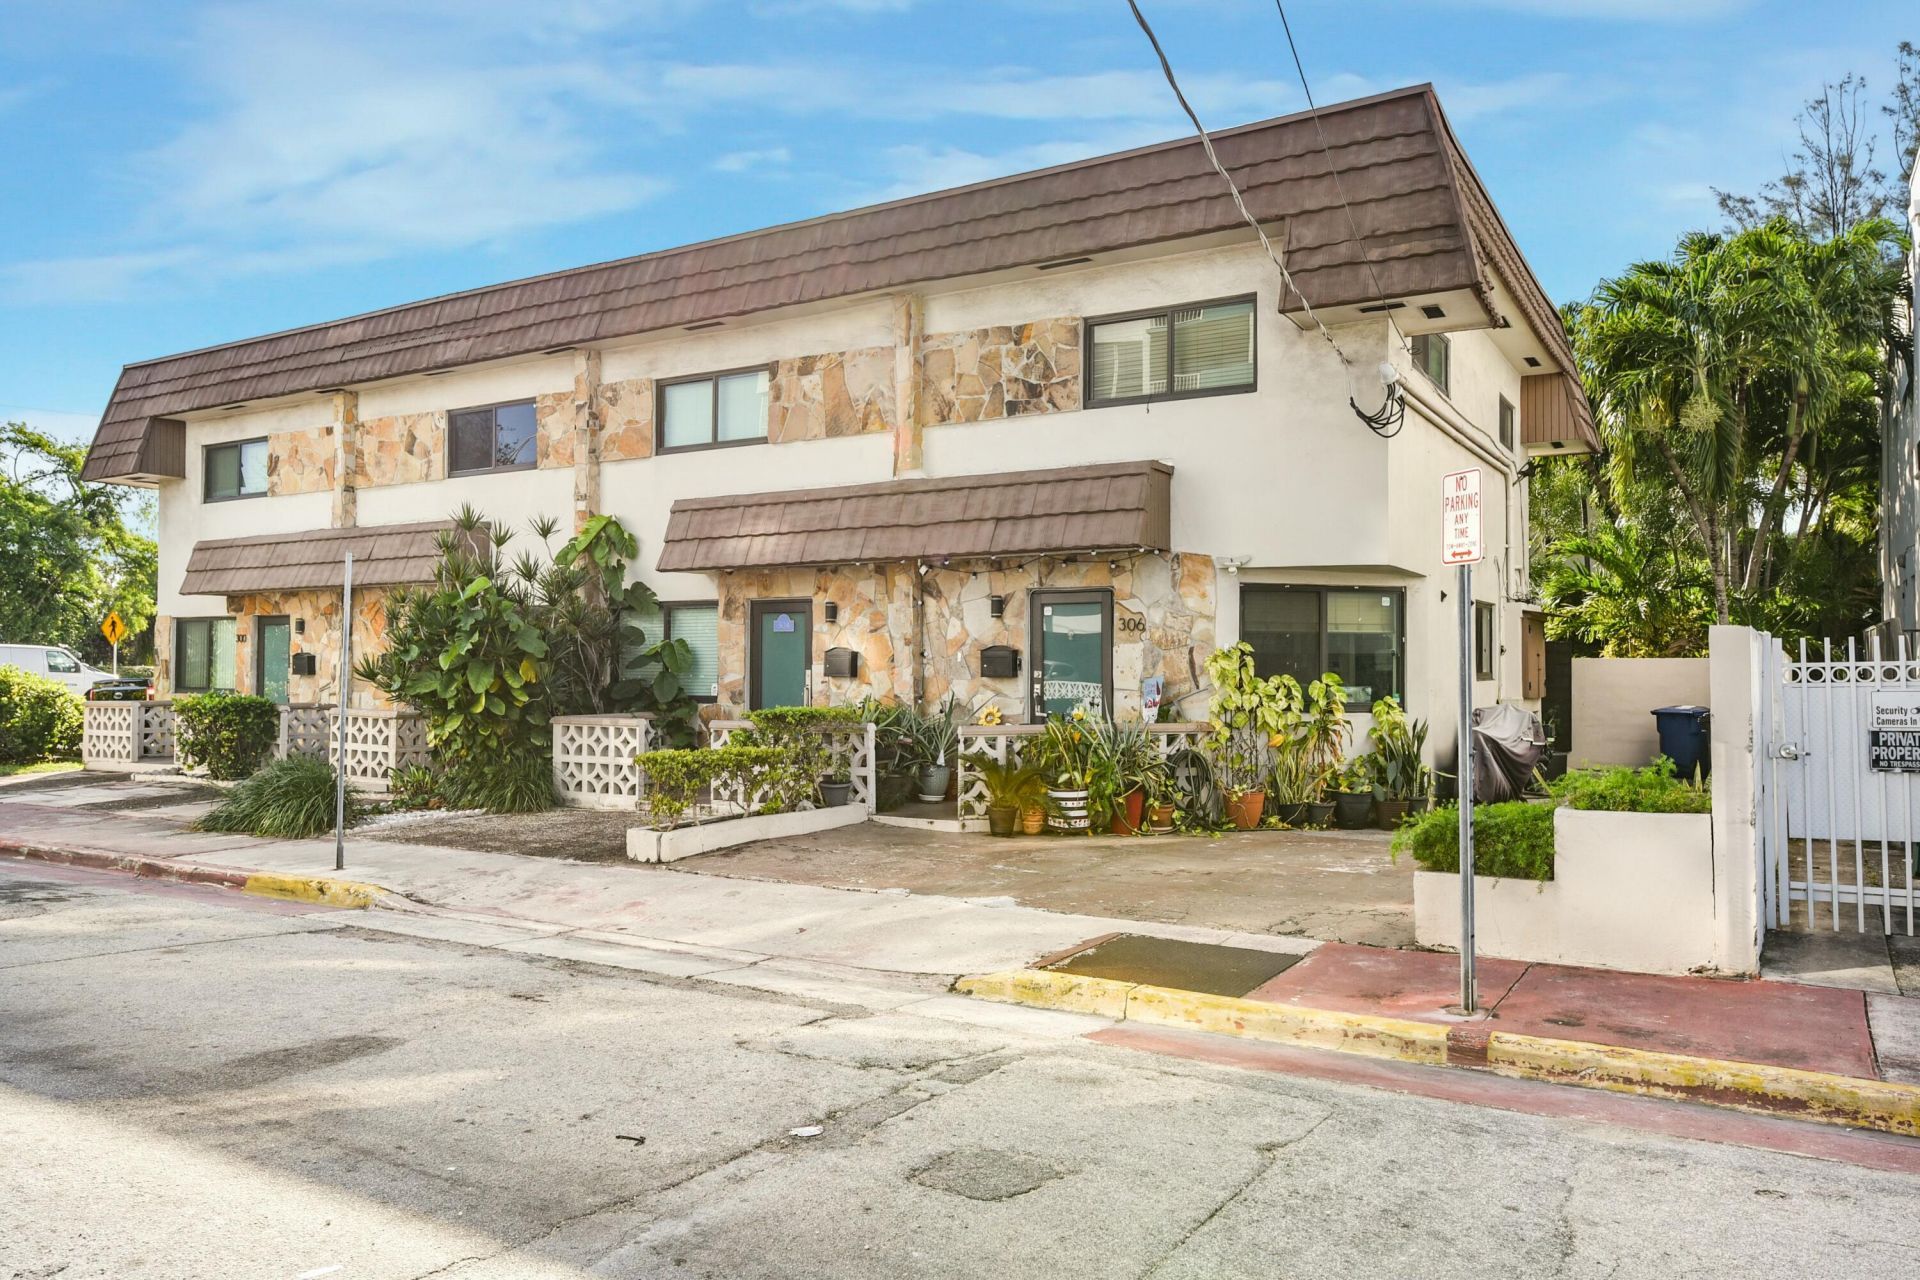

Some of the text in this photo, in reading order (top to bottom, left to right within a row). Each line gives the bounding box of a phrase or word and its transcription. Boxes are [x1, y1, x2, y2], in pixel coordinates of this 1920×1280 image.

[1456, 475, 1467, 492] NO
[1445, 492, 1478, 512] PARKING
[1455, 513, 1468, 525] ANY
[1455, 527, 1469, 539] TIME
[1119, 617, 1145, 631] 306
[1876, 706, 1908, 716] Security
[1877, 717, 1908, 726] Cameras
[1879, 732, 1920, 747] PRIVAT
[1872, 746, 1920, 760] PROPER
